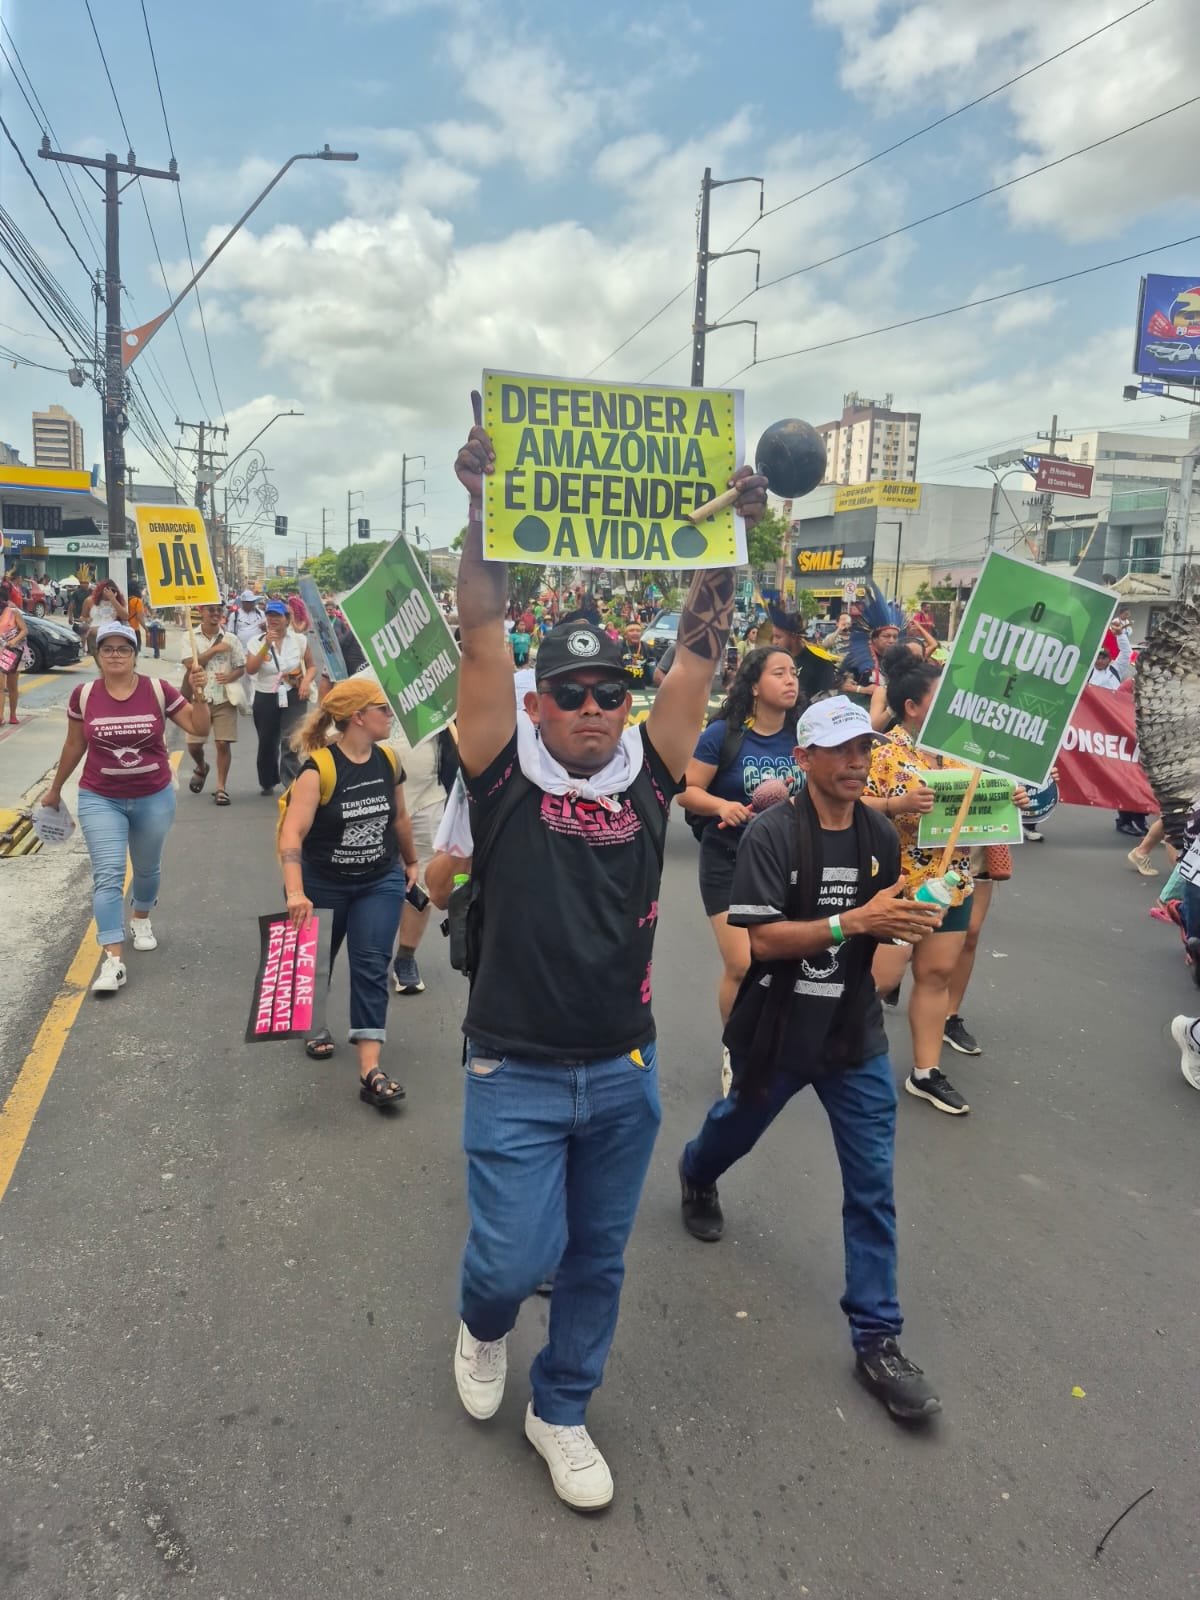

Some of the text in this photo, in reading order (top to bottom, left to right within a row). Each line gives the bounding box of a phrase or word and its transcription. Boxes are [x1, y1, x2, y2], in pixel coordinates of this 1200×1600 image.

[501, 384, 719, 437] DEFENDER A
[515, 427, 708, 478] AMAZÔNIA
[504, 466, 717, 523] É DEFENDER
[148, 522, 197, 535] DEMARCAÇÃO
[553, 517, 671, 561] A VIDA
[158, 535, 206, 587] JÁ!
[799, 550, 867, 572] SMILE PNEUS
[370, 588, 432, 668] FUTURO
[1030, 601, 1047, 624] O
[968, 613, 1081, 686] FUTURO
[1003, 673, 1018, 699] É
[947, 688, 1049, 746] ANCESTRAL
[341, 795, 388, 810] TERRITÓRIOS
[256, 925, 286, 1031] RESISTANCE
[275, 958, 295, 1033] CLIMATE
[294, 940, 317, 1006] WE ARE
